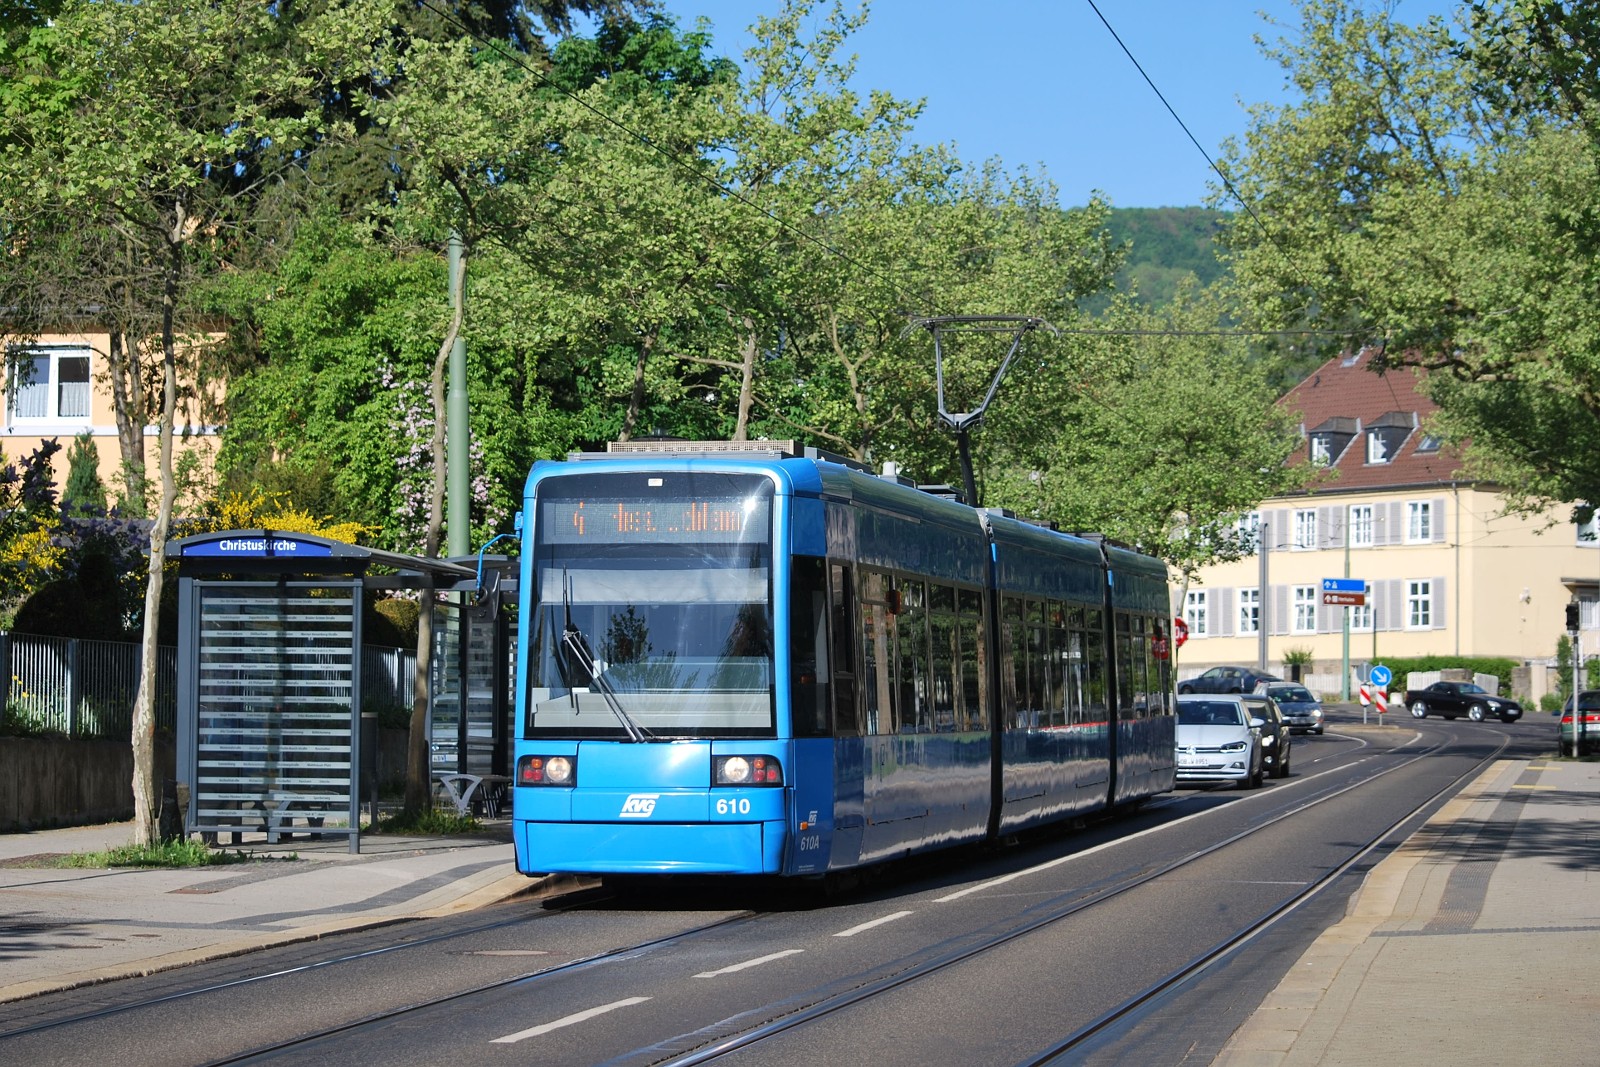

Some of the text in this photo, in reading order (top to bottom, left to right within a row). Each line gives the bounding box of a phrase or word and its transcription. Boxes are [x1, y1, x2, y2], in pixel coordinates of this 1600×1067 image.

[219, 539, 297, 551] Christuskirche
[619, 795, 660, 817] KVG
[716, 798, 751, 815] 610
[800, 835, 819, 851] 610A
